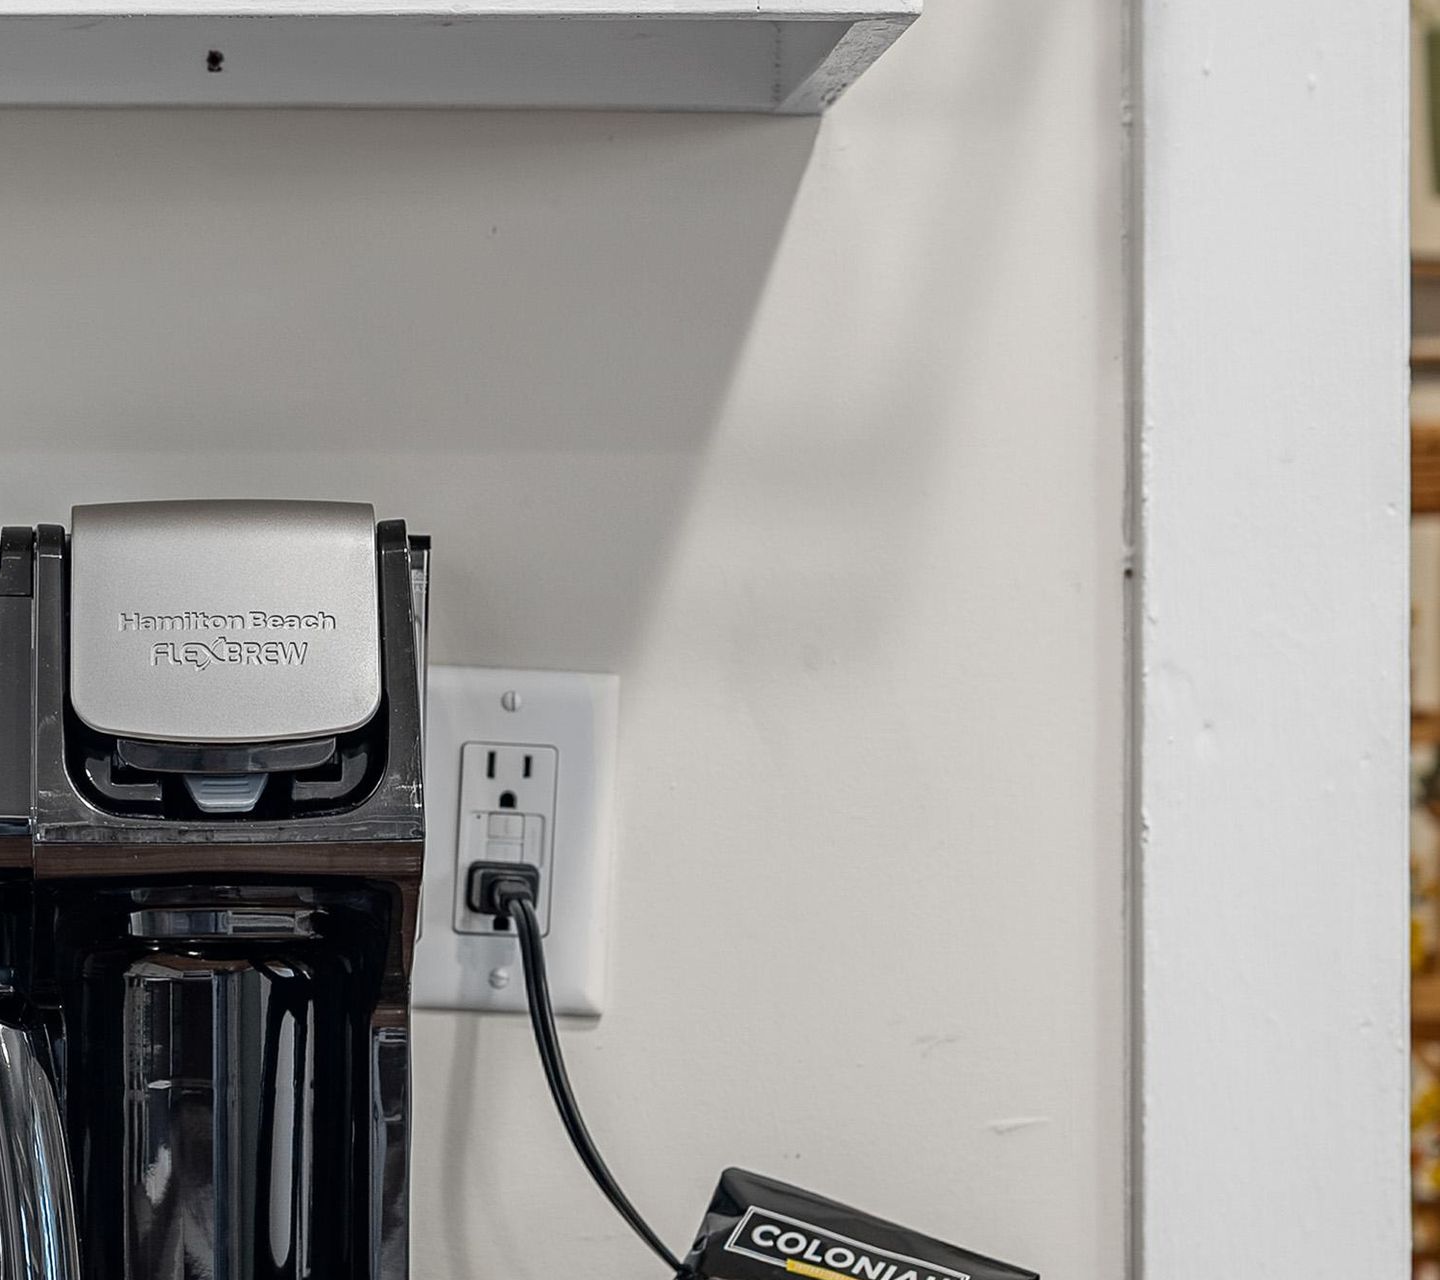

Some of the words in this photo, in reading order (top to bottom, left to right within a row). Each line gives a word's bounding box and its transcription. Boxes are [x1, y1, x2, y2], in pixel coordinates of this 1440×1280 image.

[118, 612, 245, 631] Hamilton
[249, 611, 336, 629] Beach
[151, 637, 308, 671] FLEXBREW
